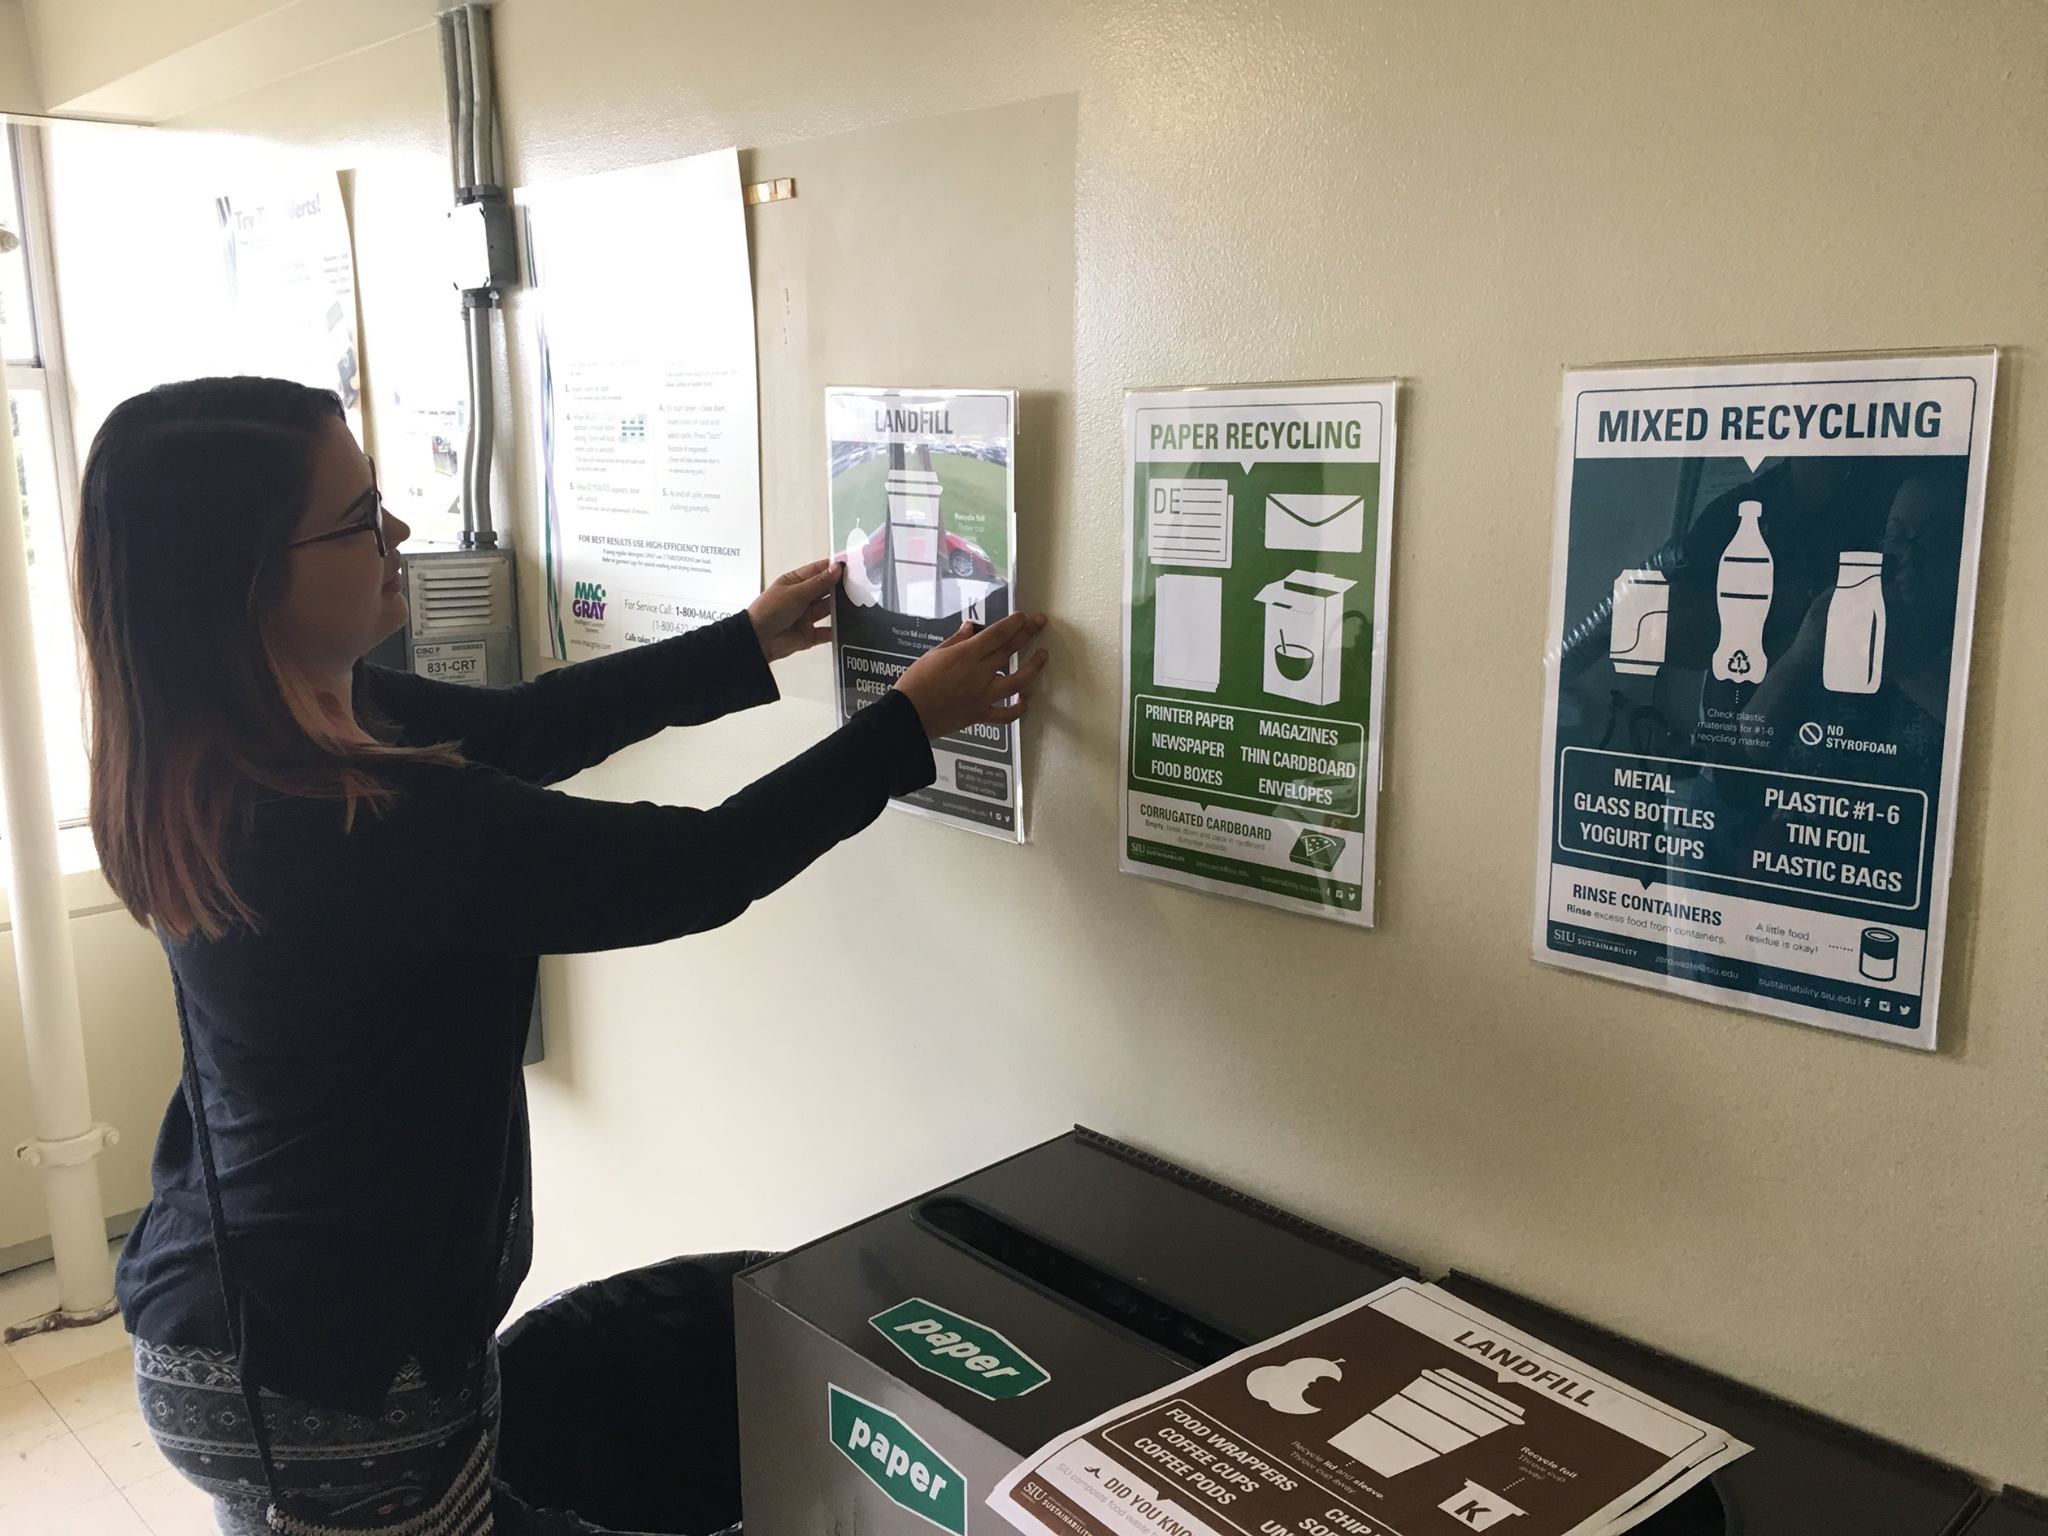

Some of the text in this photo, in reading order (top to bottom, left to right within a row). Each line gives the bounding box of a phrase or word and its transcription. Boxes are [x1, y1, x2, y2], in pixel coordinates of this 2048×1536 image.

[875, 409, 953, 435] LANDFILL
[1150, 420, 1361, 450] PAPER RECYCLING
[1598, 401, 1942, 442] MIXED RECYCLING
[578, 534, 741, 557] FOR BEST RESULTS USE HIGH-EFFICIENCY DETERGENT
[572, 599, 608, 621] GRAY
[624, 599, 635, 610] For
[636, 600, 658, 613] Service
[968, 596, 979, 621] K
[427, 659, 477, 674] 831-CRT
[846, 655, 869, 672] FOOD
[856, 678, 886, 696] COFFEE
[1145, 704, 1234, 731] PRINTER PAPER
[1697, 721, 1774, 736] materials for #1-6
[1707, 708, 1765, 723] Check plastic
[974, 723, 1000, 741] FOOD
[1259, 719, 1339, 746] MAGAZINES
[1697, 733, 1737, 746] recycling
[1826, 725, 1844, 737] NO
[1151, 732, 1225, 758] NEWSPAPER
[1826, 737, 1898, 756] STYROFOAM
[1151, 759, 1223, 786] FOOD BOXES
[1240, 745, 1356, 779] THIN CARDBOARD
[1258, 777, 1333, 805] ENVELOPES
[1613, 768, 1676, 794] METAL
[1573, 792, 1715, 831] GLASS BOTTLES
[1764, 787, 1901, 825] PLASTIC #1-6
[1140, 803, 1204, 828] CORRUGATED
[1206, 817, 1272, 841] CARDBOARD
[1131, 842, 1146, 854] SIU
[1579, 822, 1705, 860] YOGURT CUPS
[1786, 823, 1871, 855] TIN FOIL
[1752, 849, 1903, 893] PLASTIC BAGS
[1572, 883, 1723, 926] RINSE CONTAINERS
[1566, 903, 1727, 945] Rinse excess food from containers.
[1755, 923, 1810, 941] A little food
[1745, 934, 1819, 956] residue is okay!
[1553, 928, 1576, 943] SIU
[1577, 938, 1638, 957] SUSTAINABILITY
[1758, 977, 1856, 1006] sustainability.siu.edu
[893, 1318, 1021, 1379] paper
[1453, 1330, 1596, 1408] LANDFILL
[848, 1416, 948, 1501] paper
[1157, 1427, 1260, 1493] COFFEE CUPS
[1165, 1408, 1298, 1492] FOOD WRAPPERS
[1290, 1440, 1324, 1463] Recycle
[1323, 1460, 1339, 1471] lid
[1335, 1469, 1356, 1481] and
[1520, 1446, 1578, 1479] Recycle foil
[1133, 1437, 1237, 1505] COFFEE PODS
[1289, 1451, 1317, 1469] Throw
[1315, 1467, 1333, 1480] cup
[1023, 1481, 1048, 1501] SIU
[1103, 1477, 1132, 1499] DID
[1129, 1493, 1163, 1520] YOU
[1324, 1508, 1372, 1535] CHIP
[1453, 1499, 1493, 1524] K
